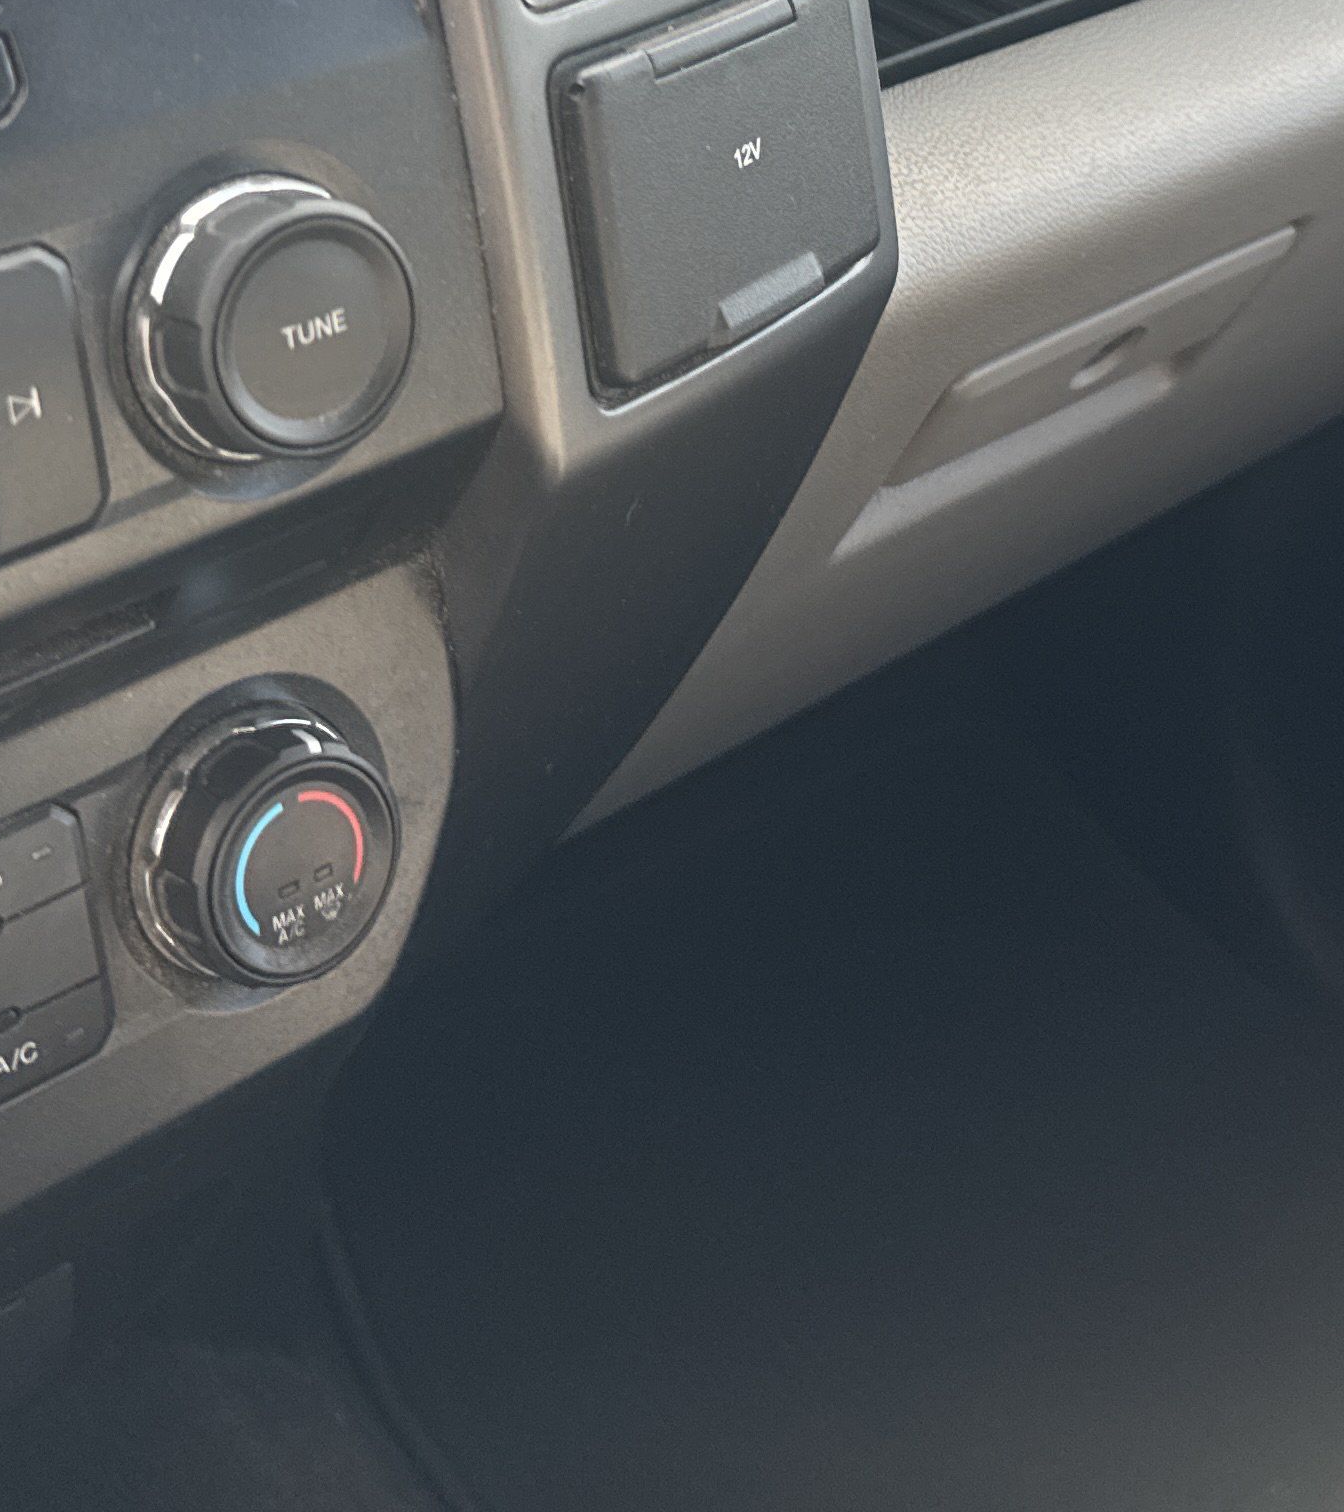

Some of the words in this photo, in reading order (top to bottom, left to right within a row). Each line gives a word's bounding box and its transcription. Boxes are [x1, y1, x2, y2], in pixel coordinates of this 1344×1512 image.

[732, 136, 762, 170] 12V
[280, 307, 348, 350] TUNE
[313, 881, 345, 911] MAX
[271, 904, 305, 932] MAX
[278, 925, 305, 945] A/C
